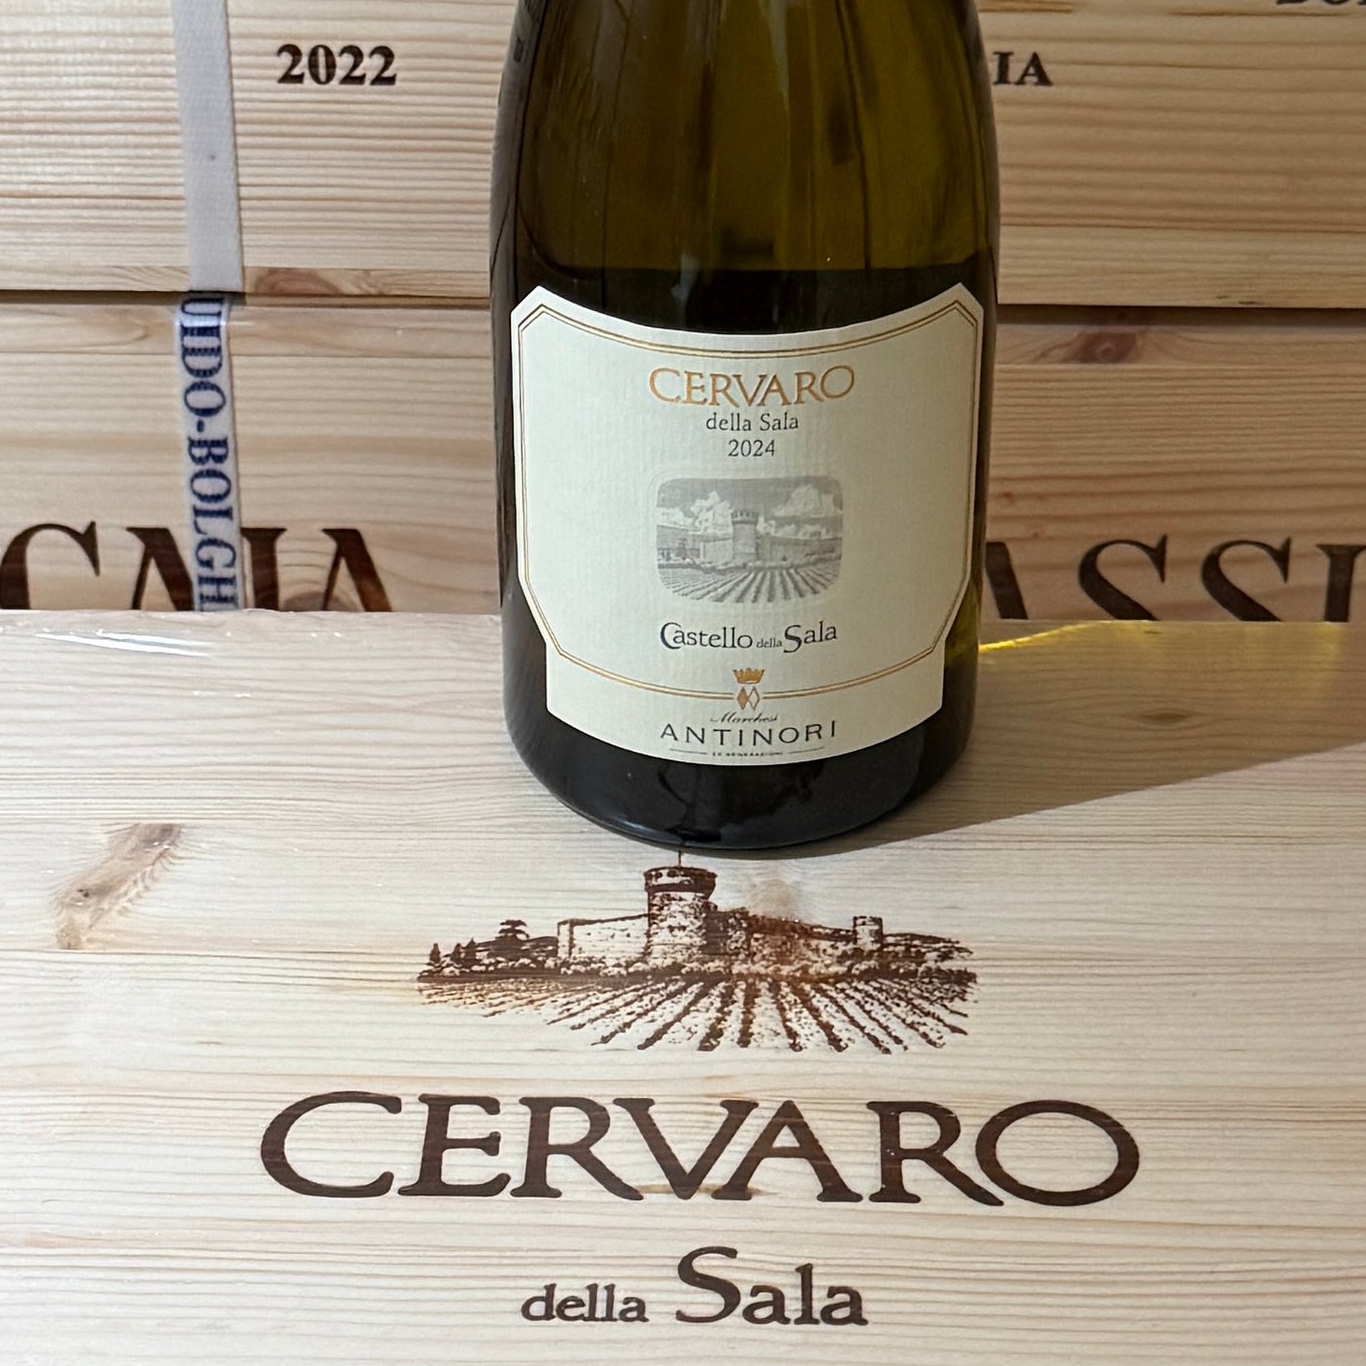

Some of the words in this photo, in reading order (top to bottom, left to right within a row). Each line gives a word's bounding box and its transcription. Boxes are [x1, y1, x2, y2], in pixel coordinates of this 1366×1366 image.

[276, 44, 397, 86] 2022
[648, 365, 856, 408] CERVARO
[705, 412, 753, 432] della
[759, 412, 800, 432] Sala
[727, 439, 777, 458] 2024
[660, 622, 754, 650] Castello
[756, 637, 783, 649] della
[783, 620, 838, 653] Sala
[660, 720, 836, 746] ANTINORI
[260, 1090, 1141, 1207] CERVARO
[520, 1282, 650, 1325] della
[674, 1245, 869, 1327] Sala
